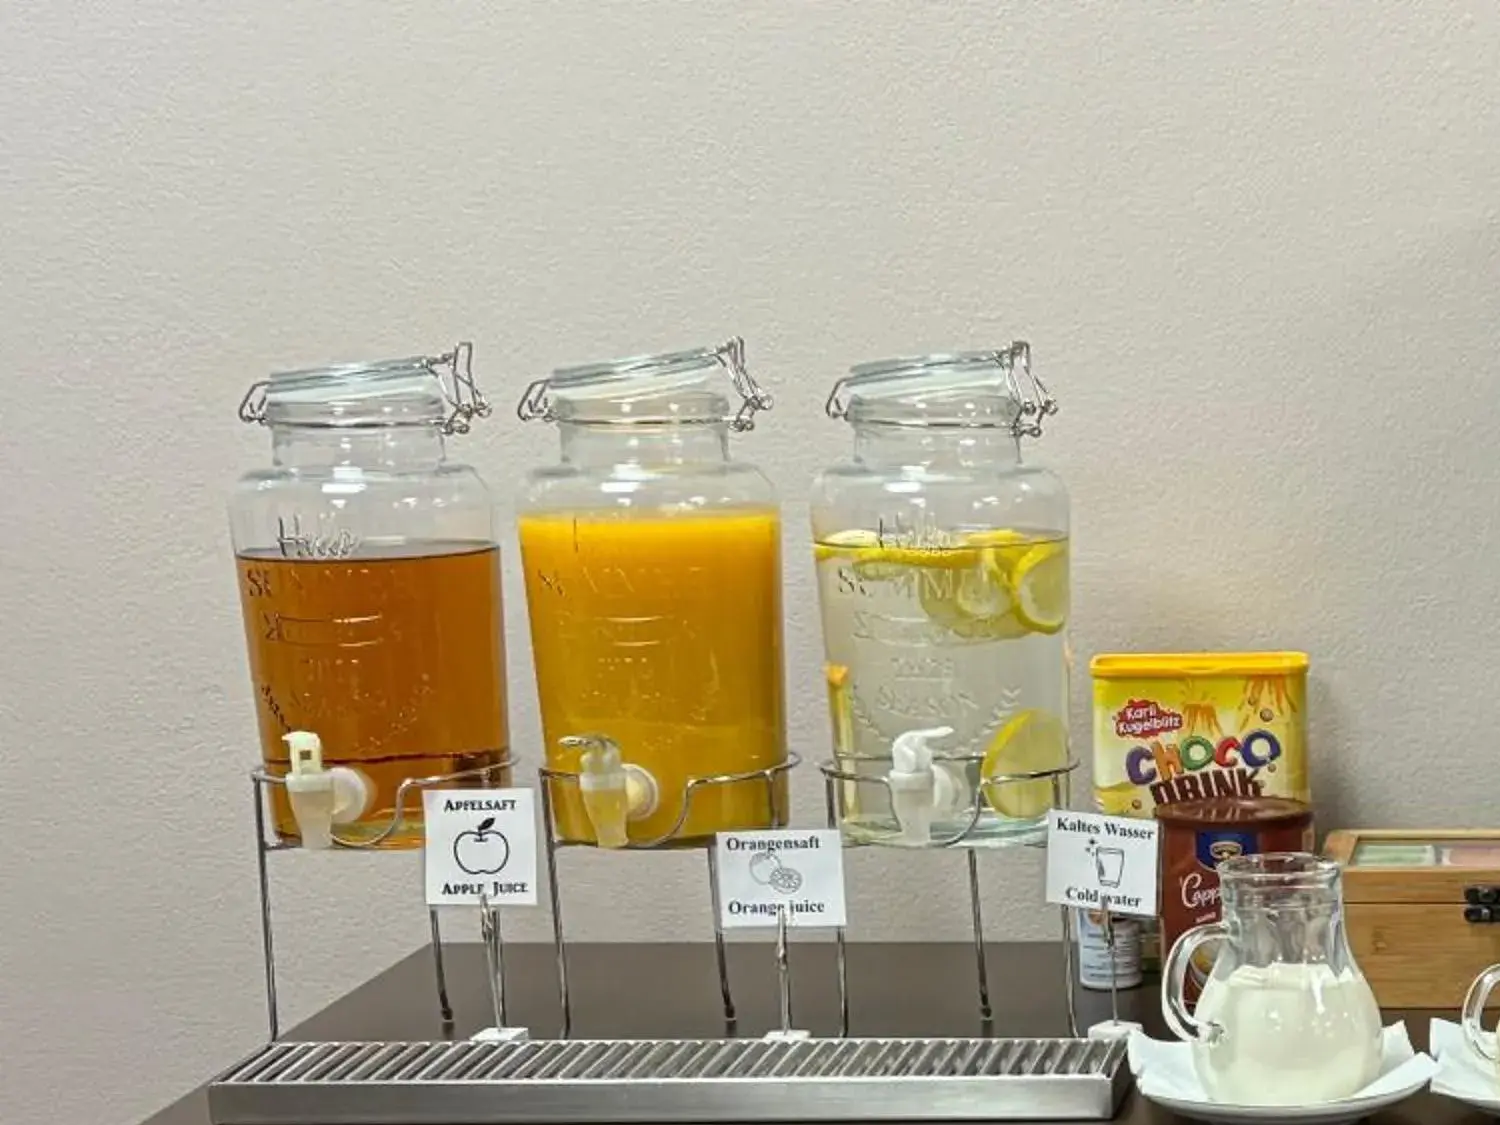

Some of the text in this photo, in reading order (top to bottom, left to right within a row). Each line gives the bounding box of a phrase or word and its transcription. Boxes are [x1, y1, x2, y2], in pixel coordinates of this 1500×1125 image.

[1126, 729, 1282, 785] CHOCO
[1150, 768, 1264, 805] DRINK
[1057, 817, 1155, 840] Kaltes Wasser
[726, 835, 821, 852] Orangensaft
[728, 899, 825, 916] Orange juice
[1065, 886, 1143, 908] Cold water
